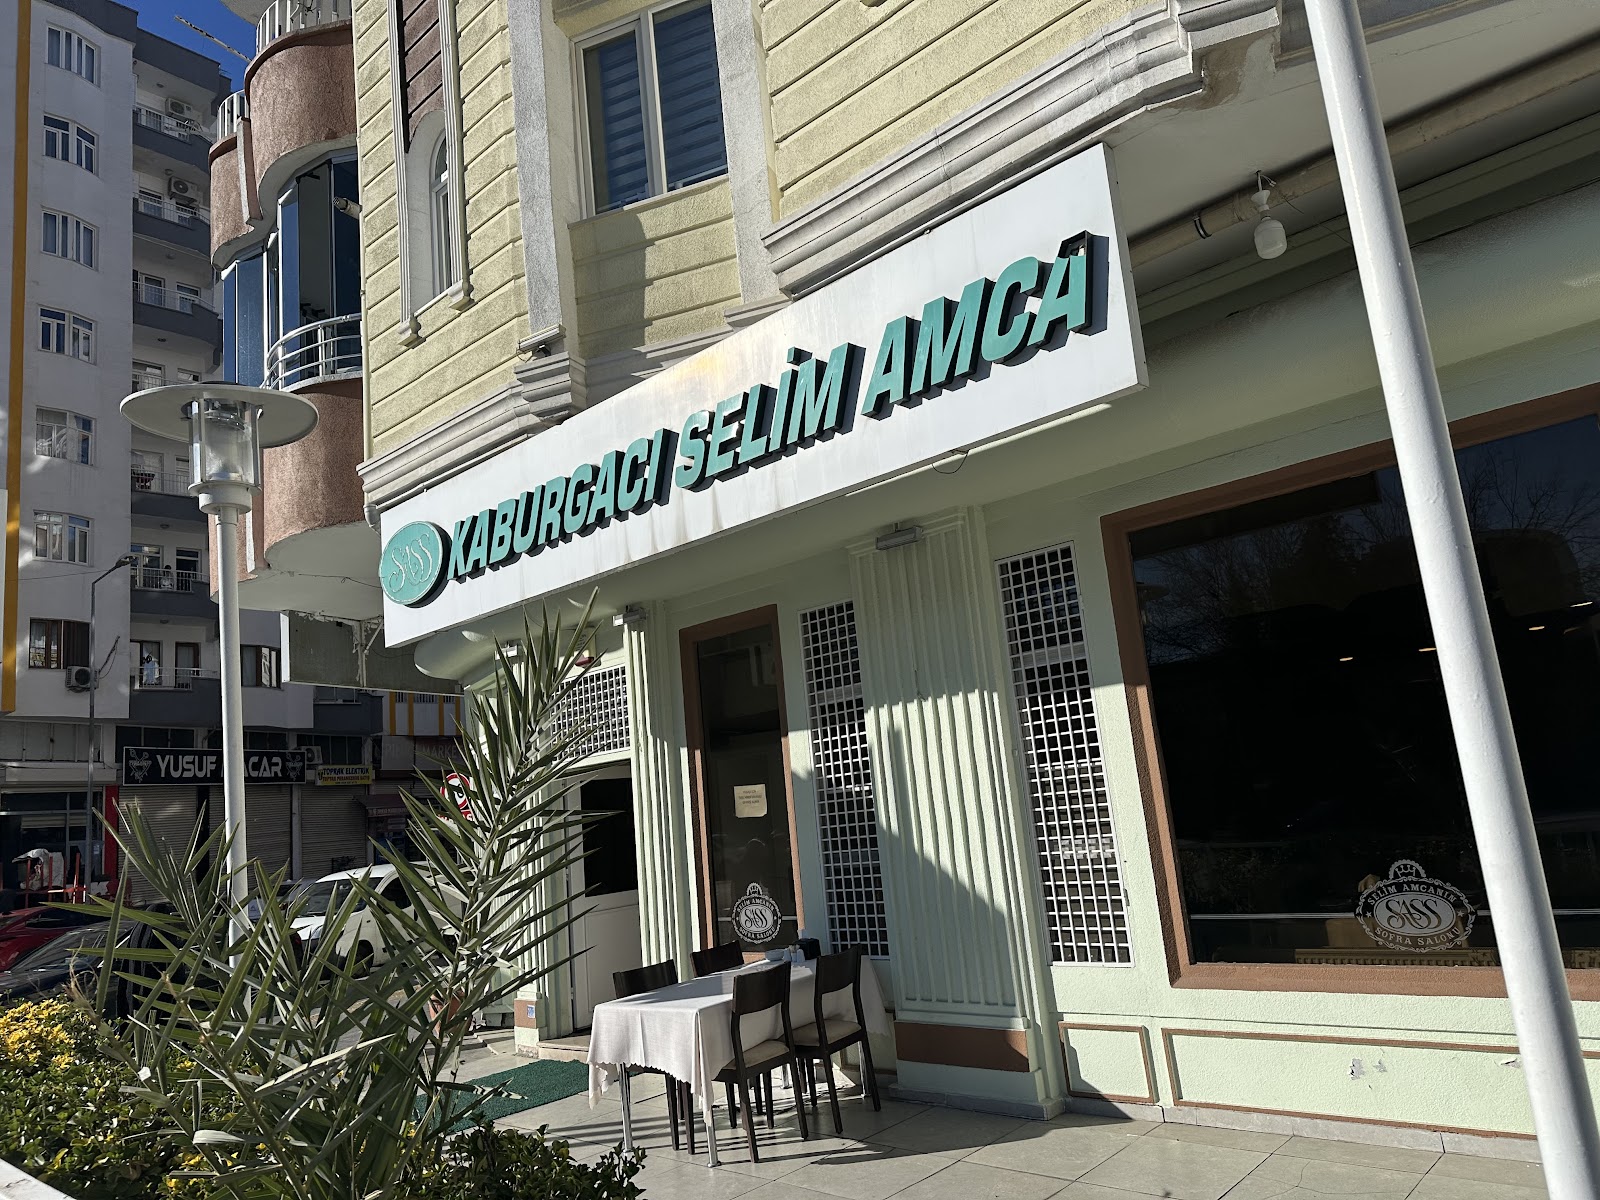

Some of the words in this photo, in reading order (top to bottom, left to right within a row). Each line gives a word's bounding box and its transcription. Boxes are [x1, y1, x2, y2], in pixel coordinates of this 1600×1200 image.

[447, 427, 666, 582] KABURGACI
[675, 342, 852, 490] SELİM
[861, 230, 1091, 416] AMCA
[156, 755, 217, 778] YUSUF
[323, 767, 344, 775] TOPRAK
[1367, 885, 1398, 906] SELİM
[1402, 883, 1457, 903] AMCANIN
[1375, 926, 1412, 945] SOFRA
[1417, 926, 1461, 946] SALONU
